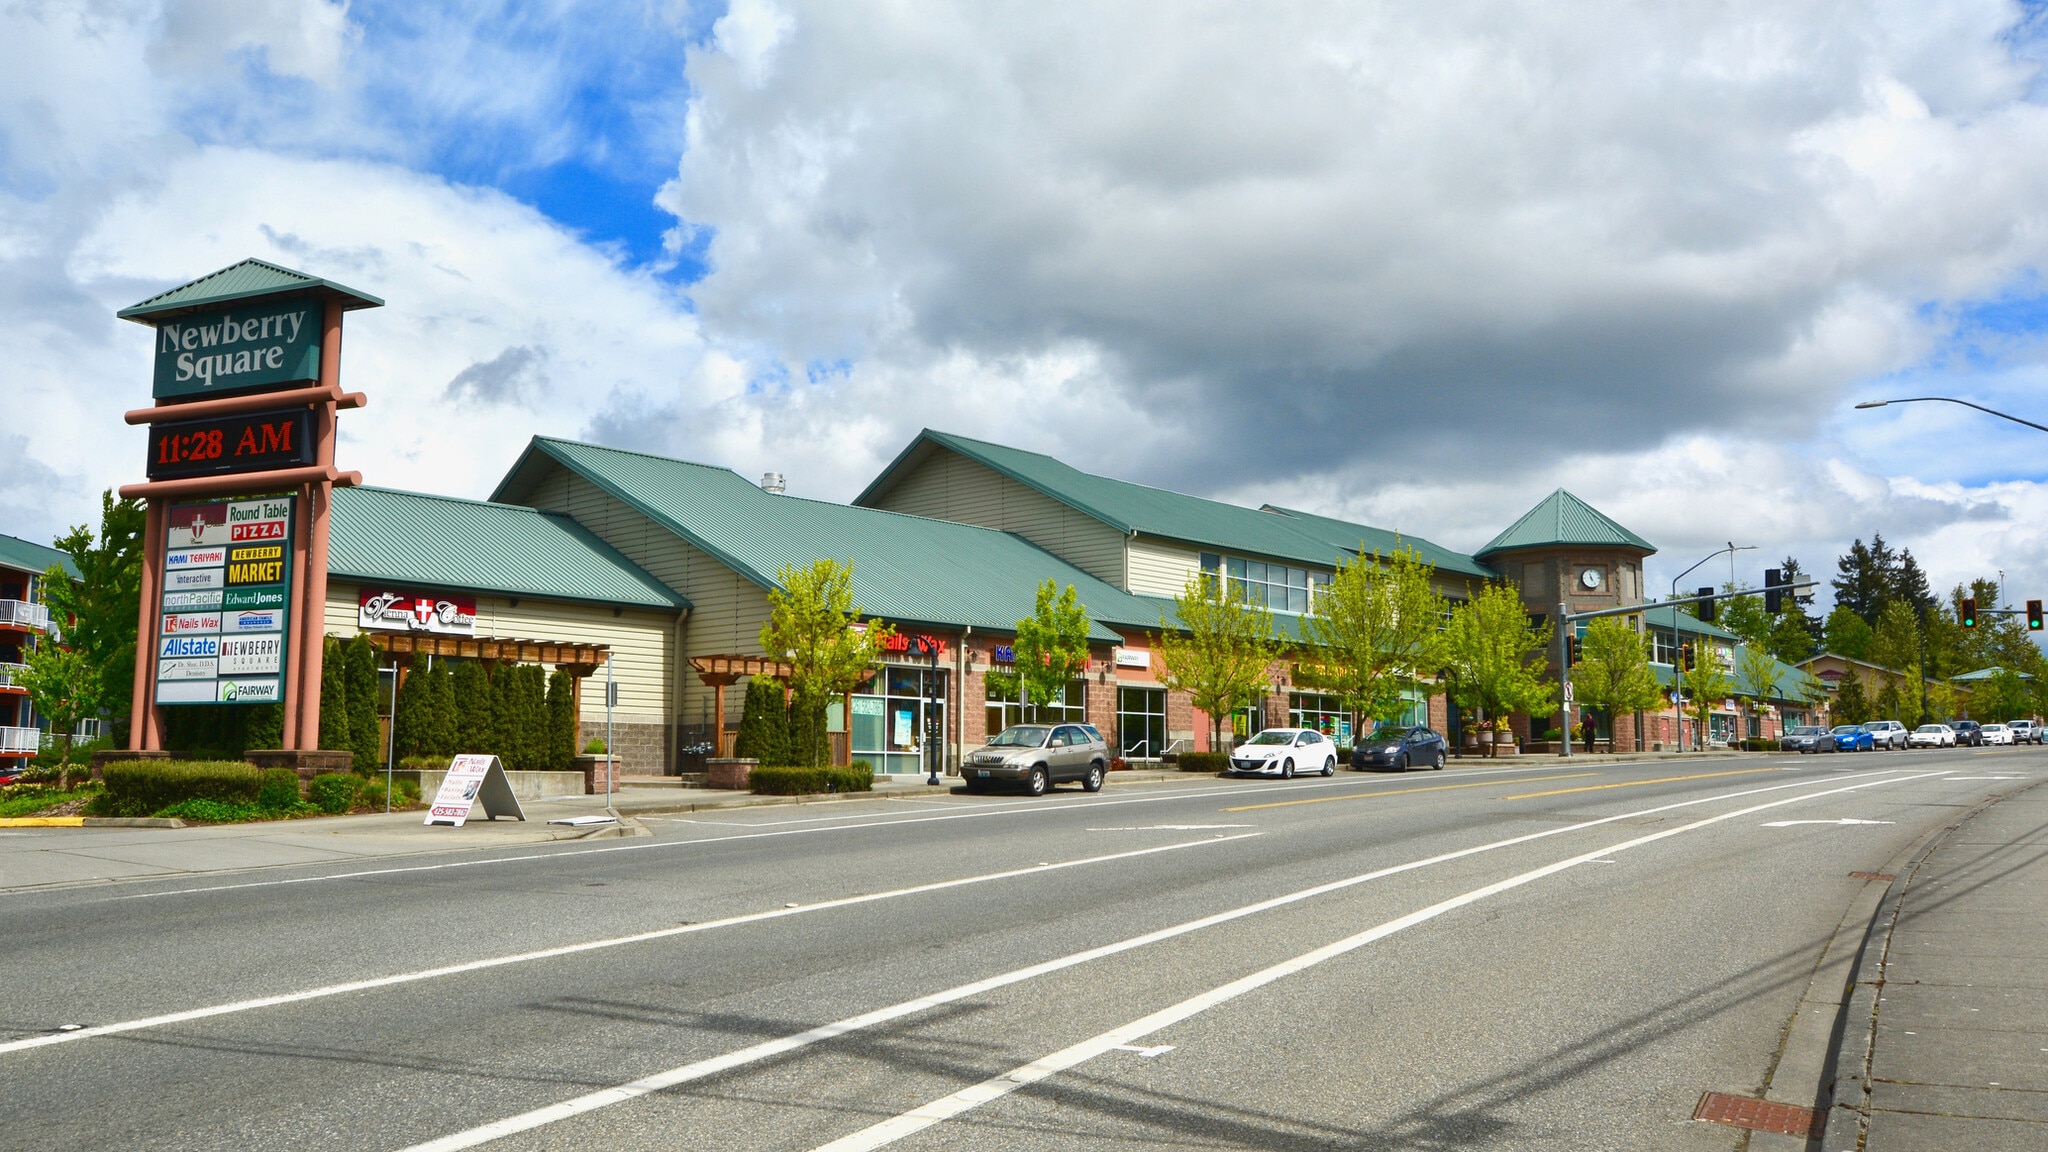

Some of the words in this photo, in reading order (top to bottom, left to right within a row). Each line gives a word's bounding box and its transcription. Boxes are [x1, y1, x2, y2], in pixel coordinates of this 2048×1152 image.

[161, 310, 307, 353] Newberry
[175, 345, 284, 387] Square
[157, 429, 224, 465] 11:28
[234, 421, 294, 457] AM
[230, 505, 260, 521] Round
[263, 503, 288, 519] Table
[233, 524, 281, 538] PIZZA
[168, 555, 188, 564] KAMI
[190, 552, 222, 563] TERIYAKI
[235, 547, 279, 559] NEWBERRY
[176, 573, 211, 584] interactive
[229, 561, 282, 583] MARKET
[165, 591, 221, 605] northPacific
[364, 596, 409, 619] Vienna
[435, 600, 474, 624] Coffee
[179, 618, 199, 629] Nails
[201, 617, 219, 628] Wax
[163, 637, 216, 655] Allstate
[222, 640, 280, 656] NEWBERRY
[233, 656, 278, 665] SQUARE
[238, 685, 274, 696] FAIRWAY
